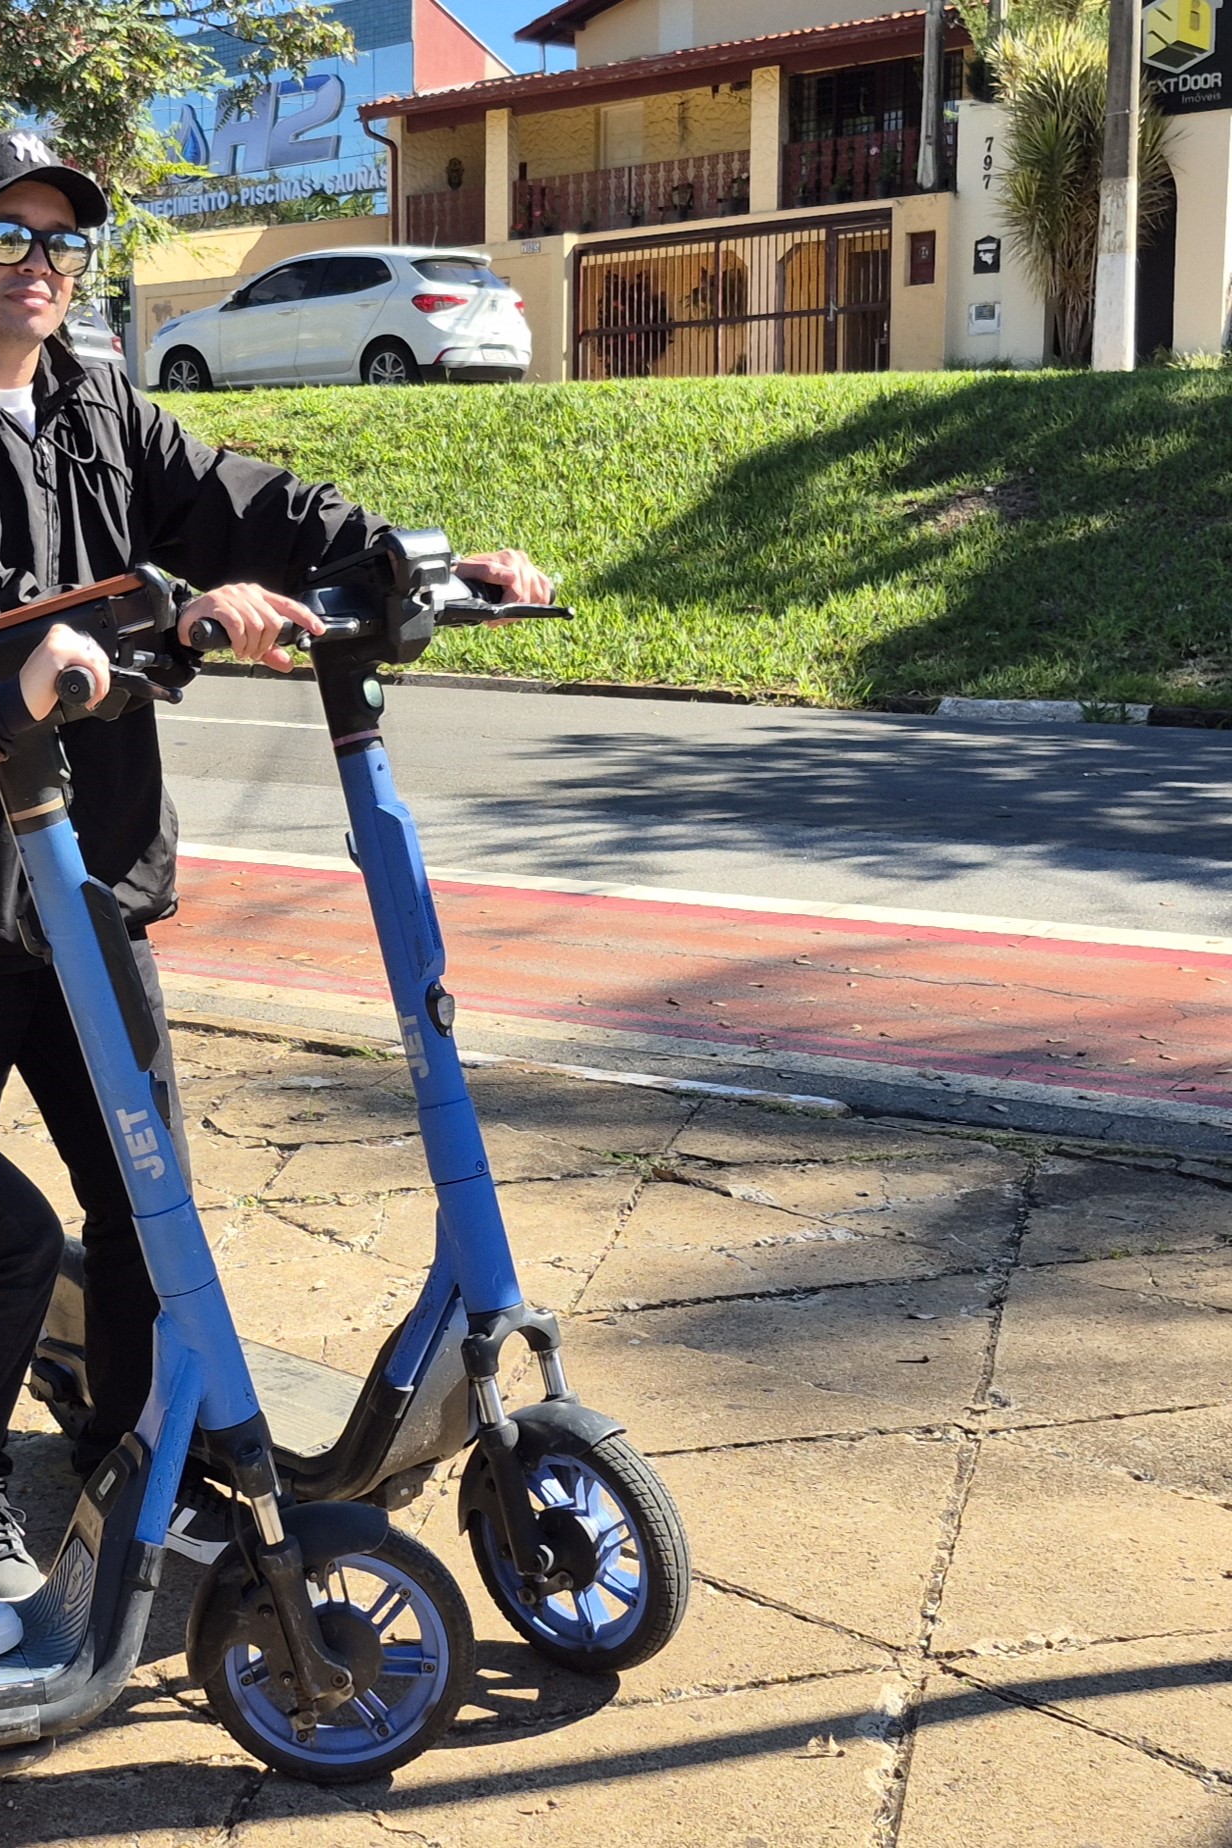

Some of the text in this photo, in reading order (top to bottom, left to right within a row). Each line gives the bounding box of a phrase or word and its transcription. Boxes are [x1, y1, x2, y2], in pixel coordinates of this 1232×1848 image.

[1148, 72, 1222, 95] EXTDOOR
[211, 73, 344, 175] H2
[136, 167, 388, 217] UECIMENTO PISCINAS SAUNAS
[983, 136, 994, 190] 797
[398, 1011, 430, 1079] JET
[115, 1108, 165, 1180] JET
